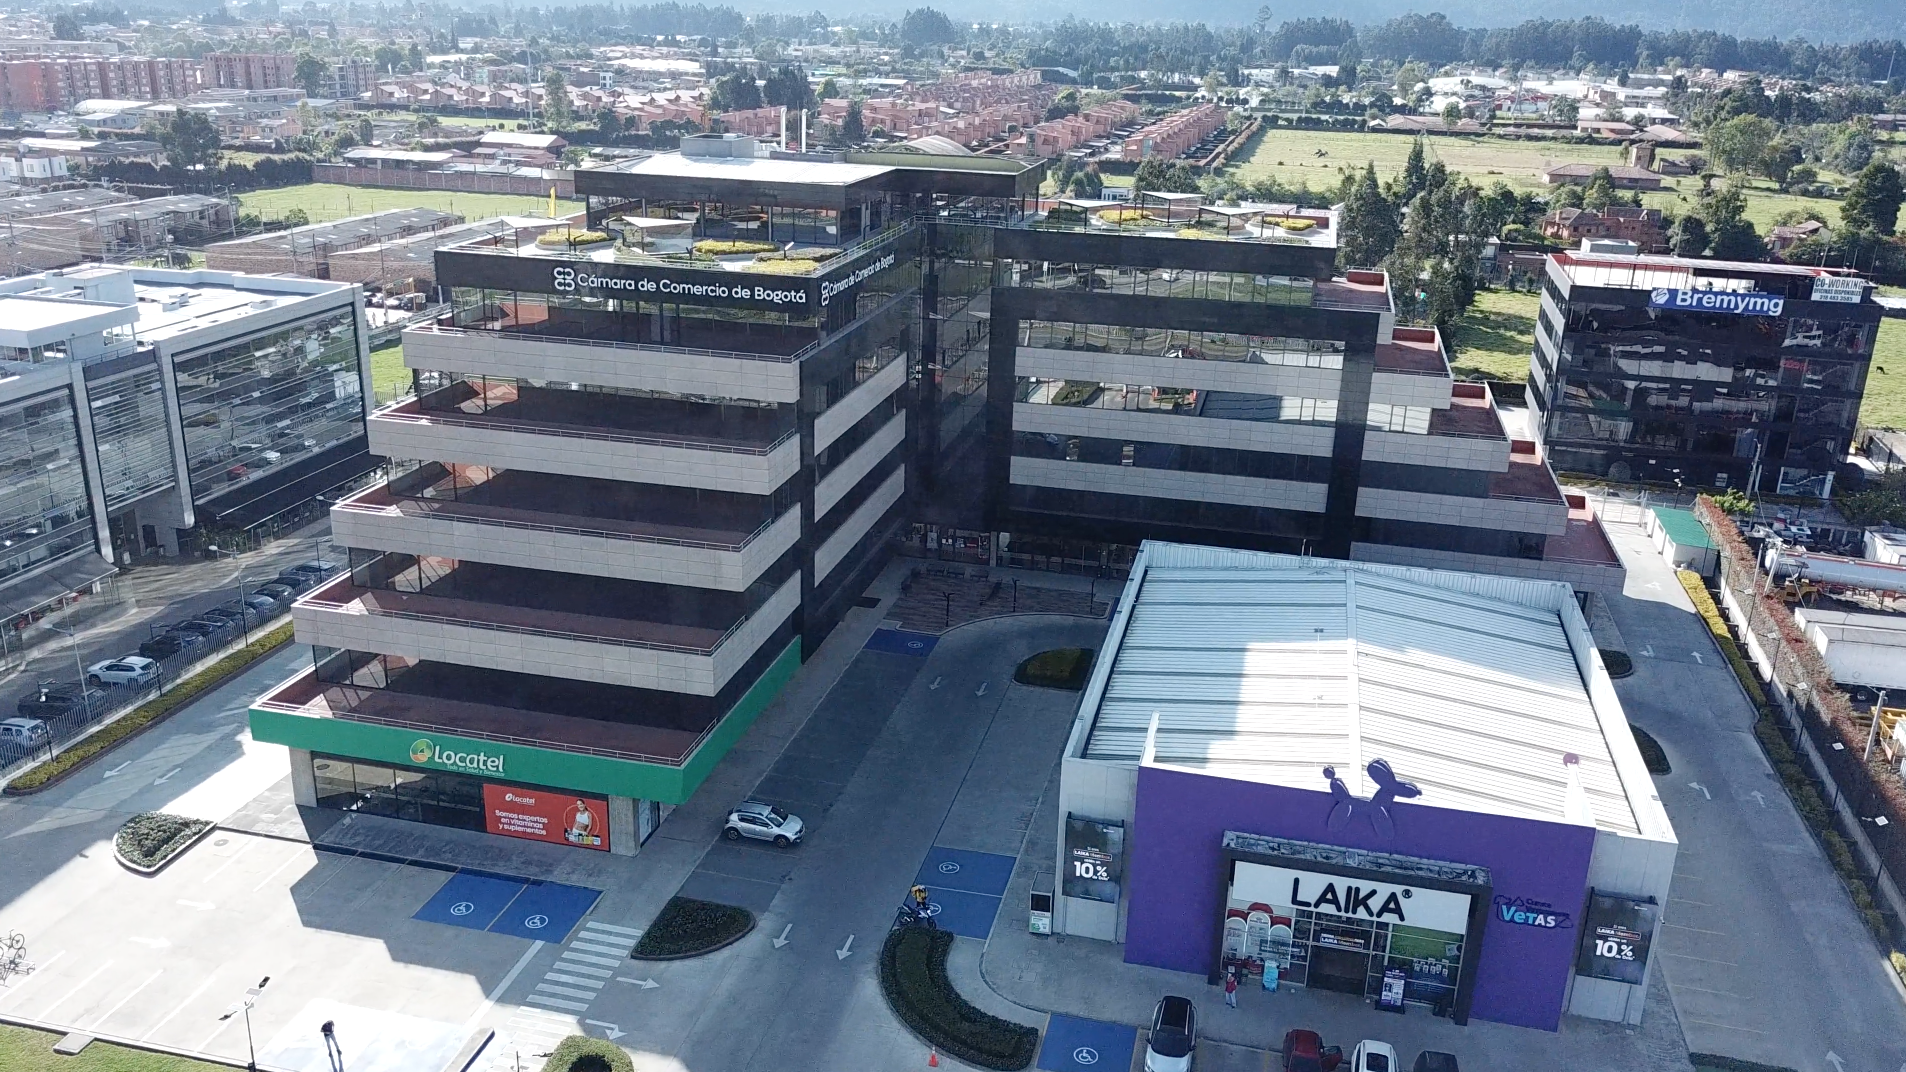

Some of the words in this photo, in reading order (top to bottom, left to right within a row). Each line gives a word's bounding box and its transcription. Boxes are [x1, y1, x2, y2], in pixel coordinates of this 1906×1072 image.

[577, 273, 635, 290] Cámara
[638, 278, 657, 291] de
[659, 279, 729, 297] Comercio
[731, 285, 751, 299] de
[754, 286, 806, 304] Bogotá
[829, 278, 849, 296] Cámara
[848, 273, 855, 286] de
[1814, 278, 1864, 290] CO-WORKING
[1675, 289, 1784, 316] Bremymg
[434, 745, 504, 772] Locatel
[512, 796, 535, 804] Locatel
[495, 809, 518, 819] Somos
[518, 814, 548, 824] expertos
[510, 818, 543, 829] vitaminas
[503, 824, 547, 835] suplementos
